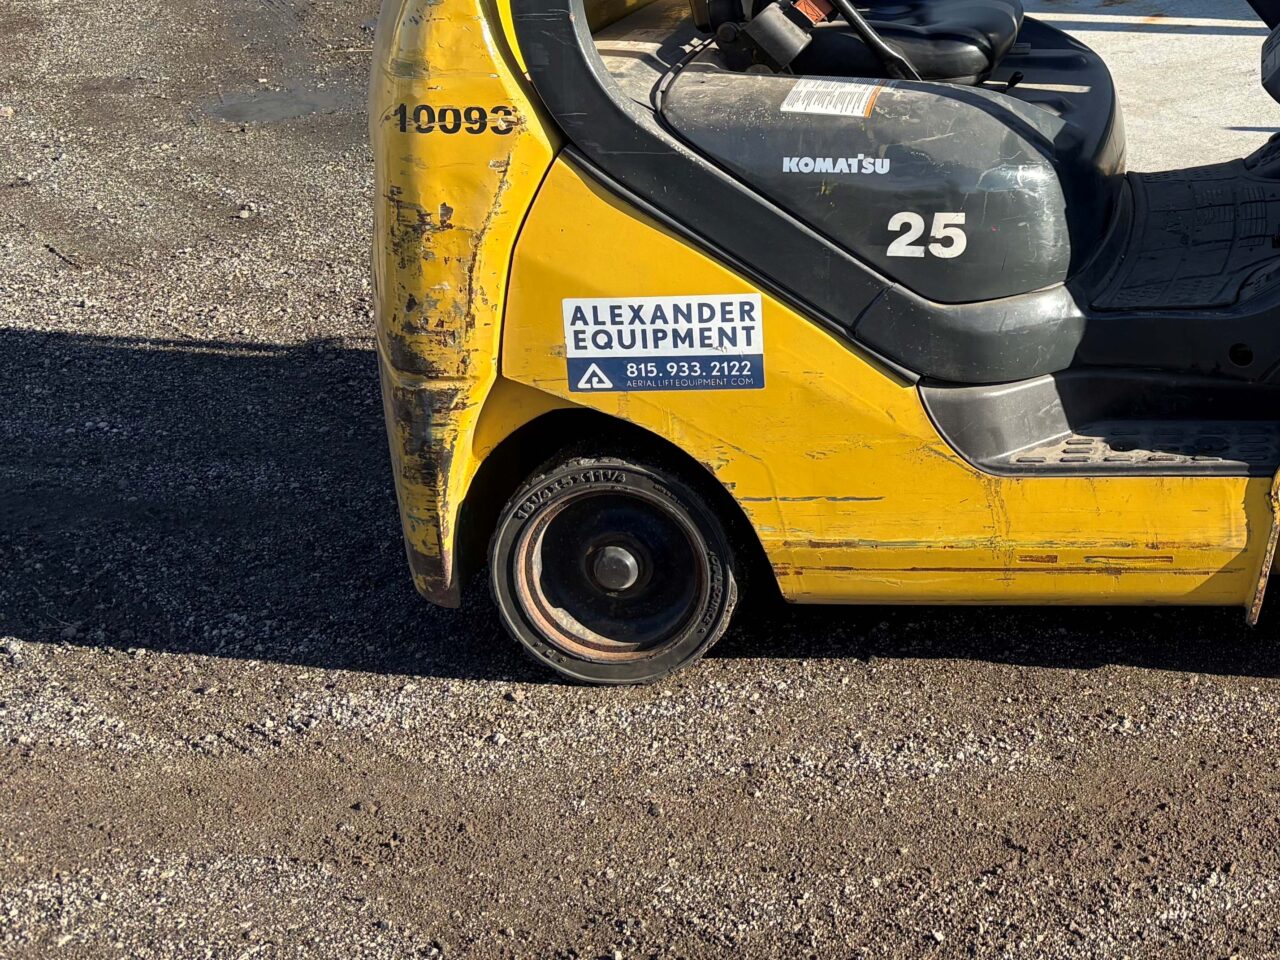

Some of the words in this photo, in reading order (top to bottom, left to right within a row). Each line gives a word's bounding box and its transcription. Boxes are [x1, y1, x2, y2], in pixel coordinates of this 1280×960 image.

[391, 103, 514, 135] 10093
[782, 153, 890, 174] KOMATSU
[886, 211, 967, 259] 25
[570, 301, 756, 326] ALEXANDER
[573, 326, 755, 351] EQUIPMENT
